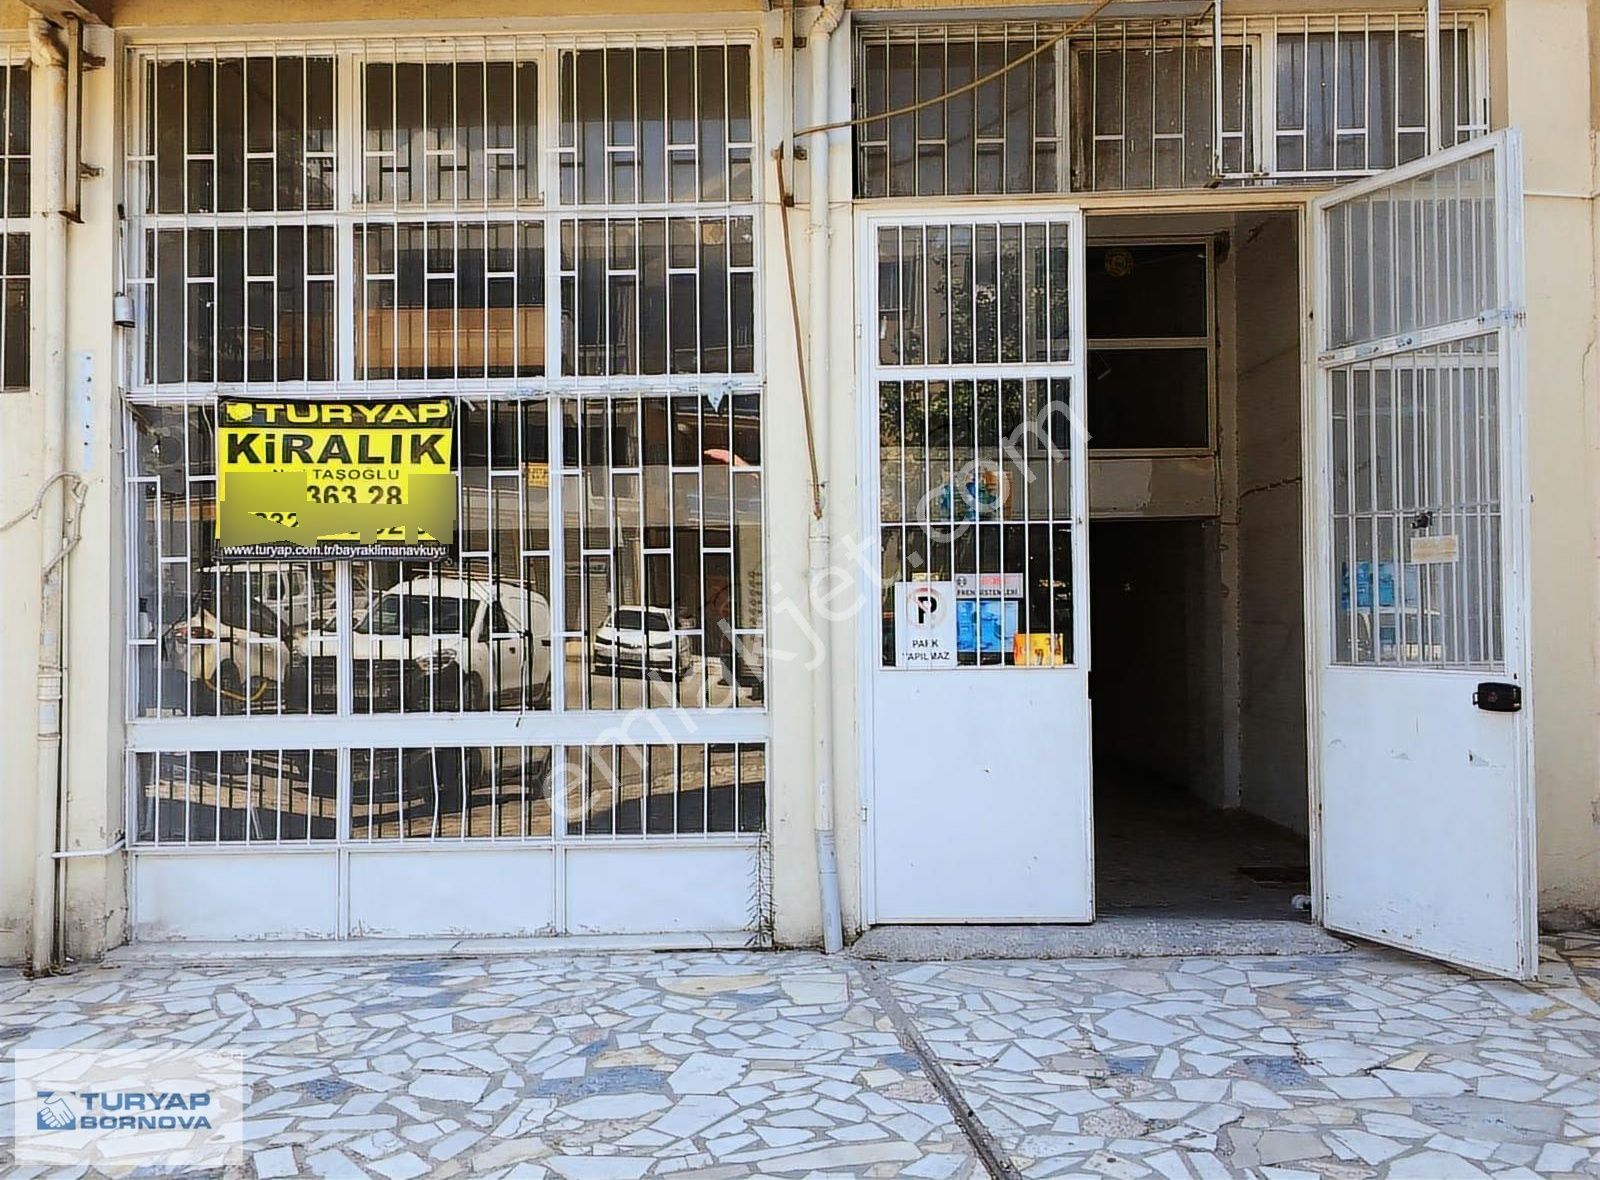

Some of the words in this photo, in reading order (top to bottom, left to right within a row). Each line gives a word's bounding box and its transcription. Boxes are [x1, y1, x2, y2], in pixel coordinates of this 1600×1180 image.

[255, 403, 449, 424] TURYAP
[306, 485, 357, 504] 363
[368, 485, 402, 505] 28
